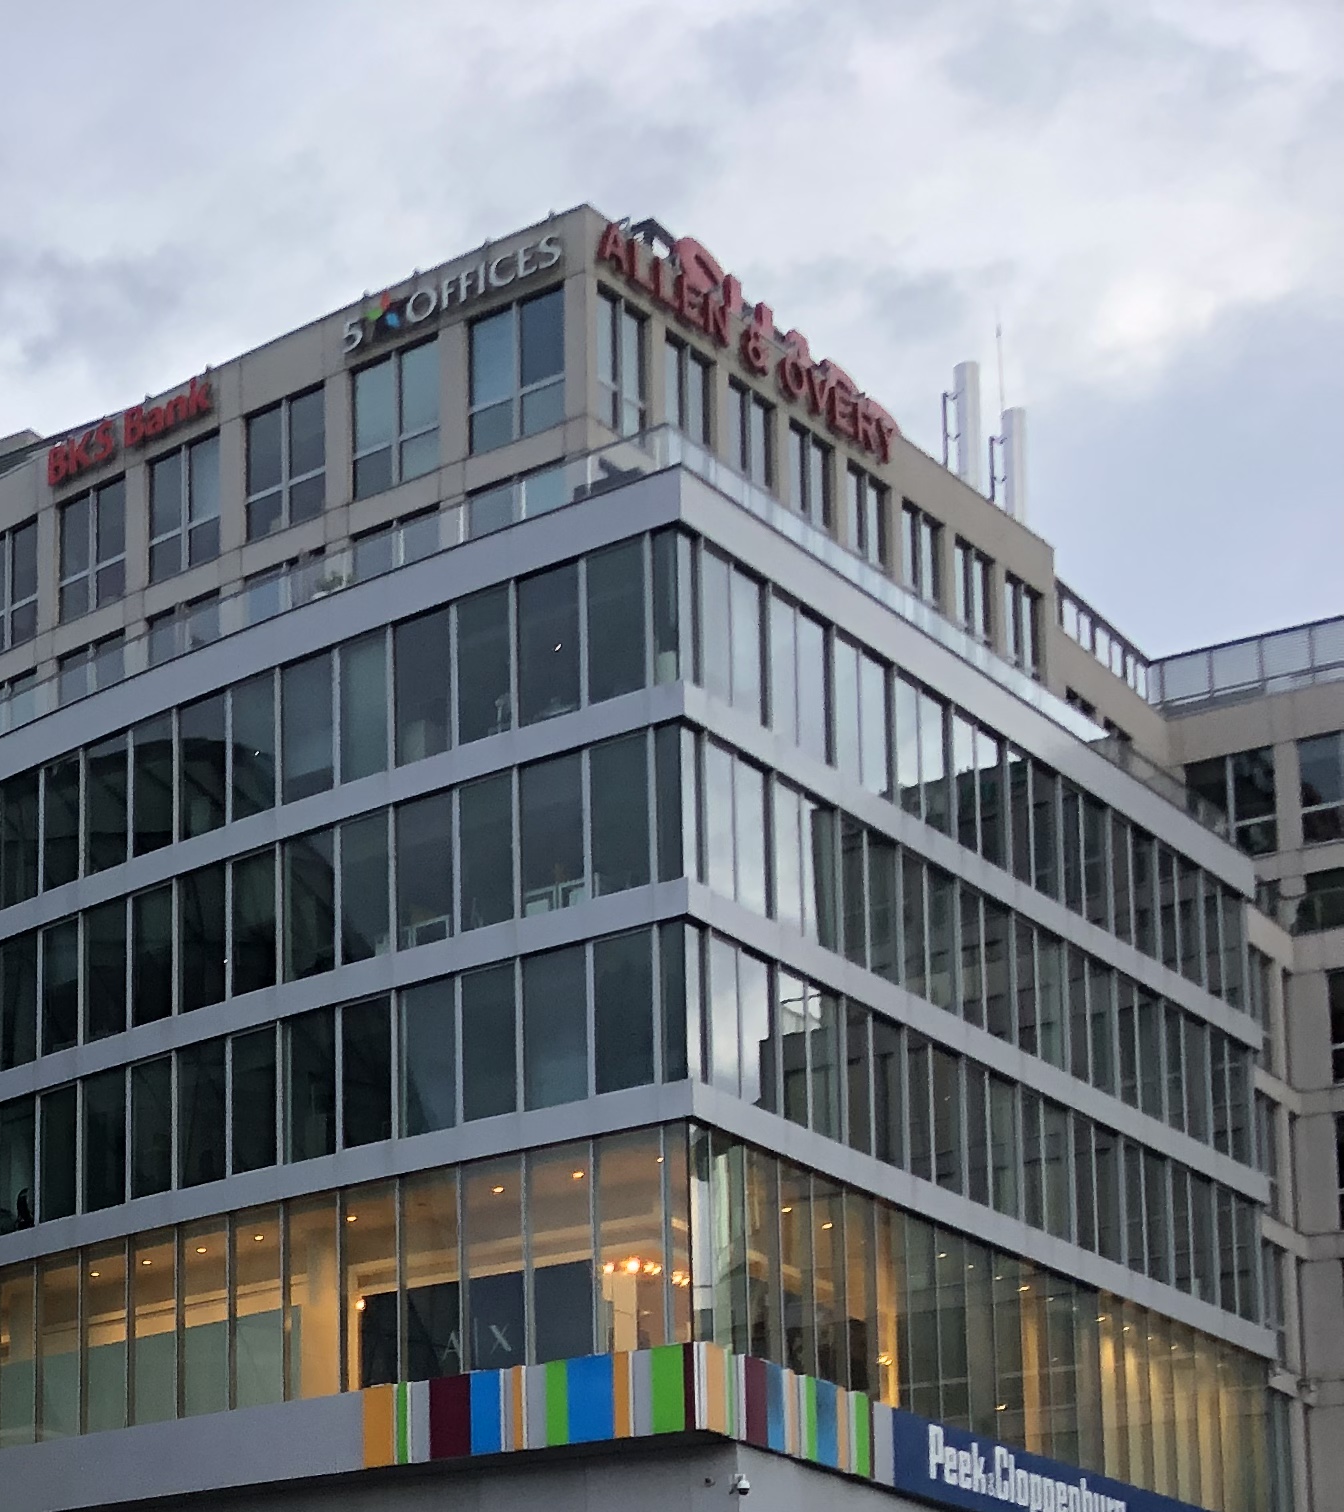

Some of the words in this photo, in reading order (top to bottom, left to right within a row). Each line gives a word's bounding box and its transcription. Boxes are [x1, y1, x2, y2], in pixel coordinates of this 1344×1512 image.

[406, 236, 562, 323] OFFICES
[597, 222, 729, 348] ALLEN
[740, 329, 769, 377] &
[779, 357, 893, 464] OVERY
[48, 419, 115, 486] BKS
[124, 376, 211, 448] Bank
